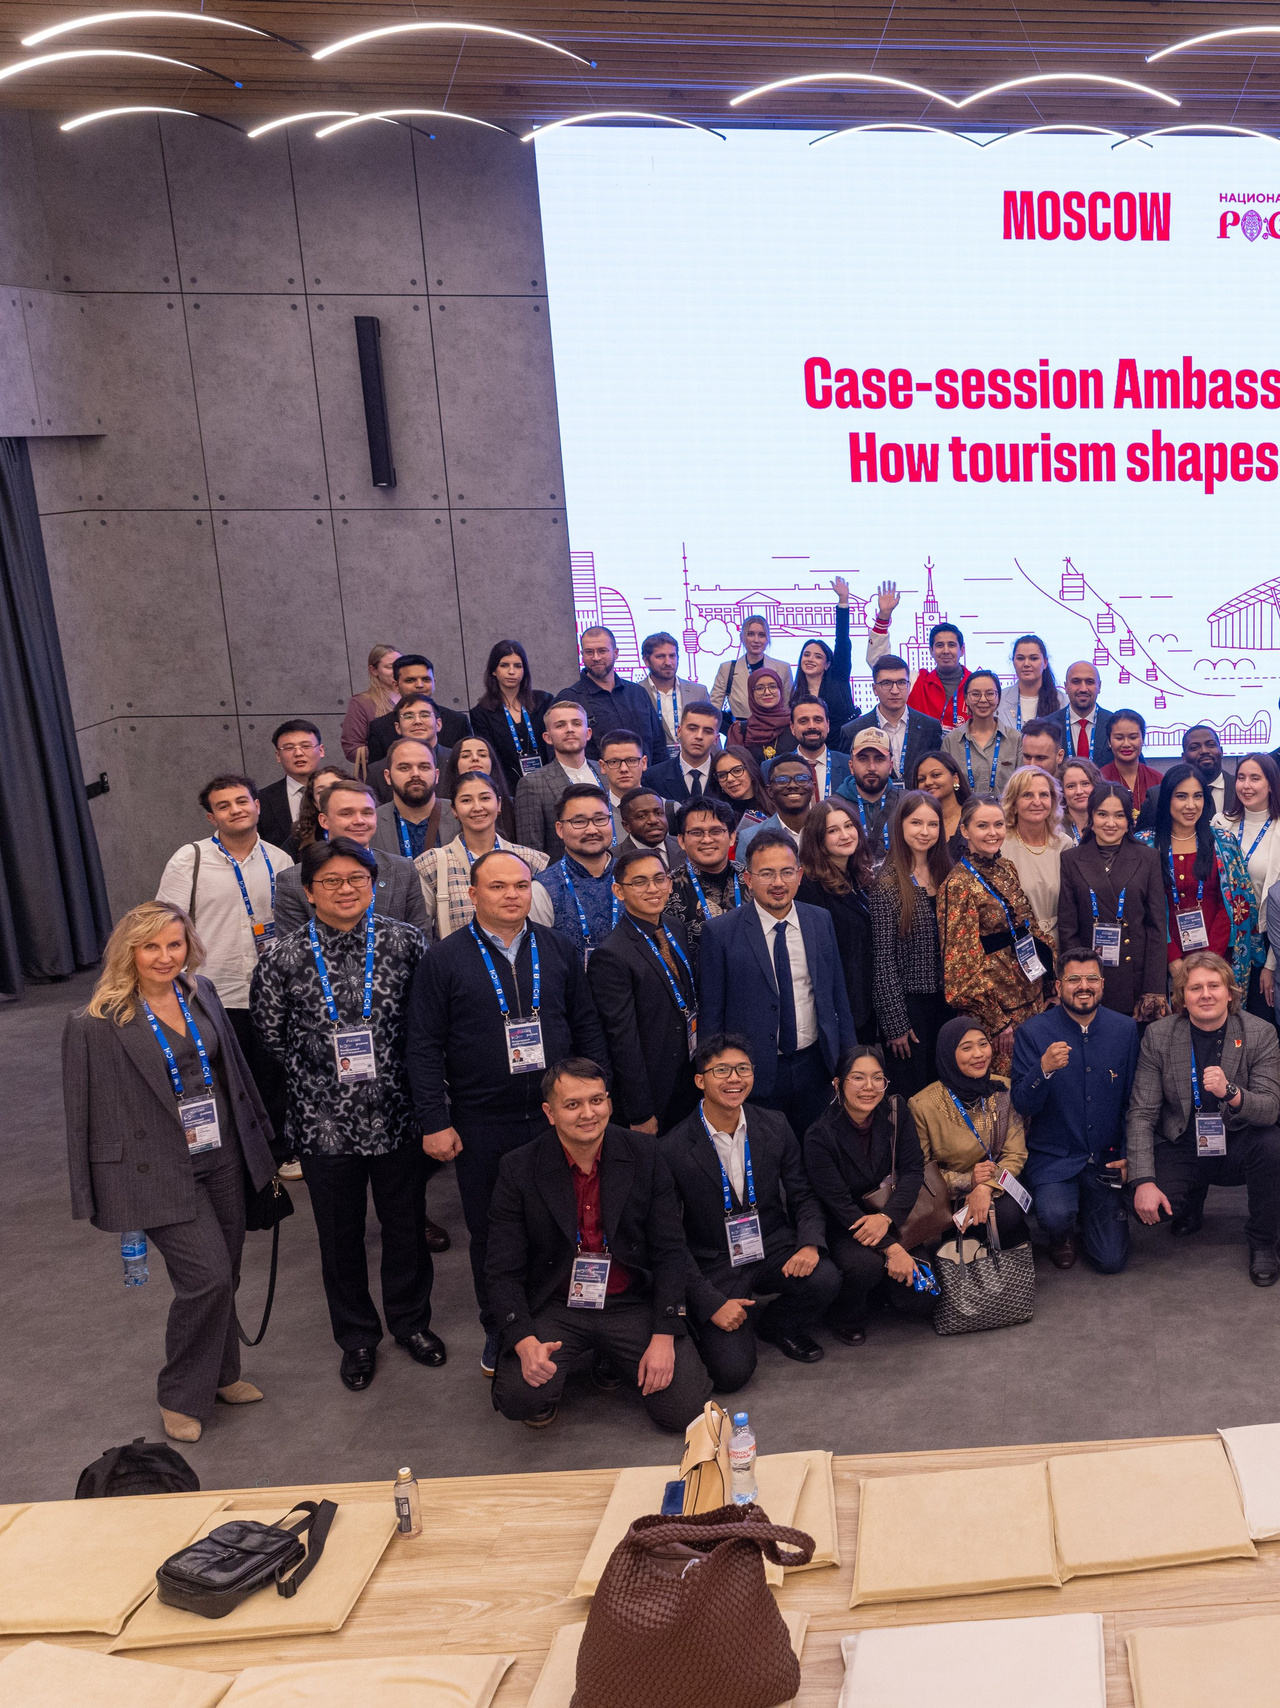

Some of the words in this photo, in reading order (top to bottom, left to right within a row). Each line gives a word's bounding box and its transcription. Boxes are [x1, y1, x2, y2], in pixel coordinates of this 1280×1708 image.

[1003, 191, 1172, 242] MOSCOW
[804, 357, 1104, 410] Case-session
[849, 432, 940, 484] How
[948, 433, 1117, 484] tourism
[1127, 429, 1279, 495] shapes
